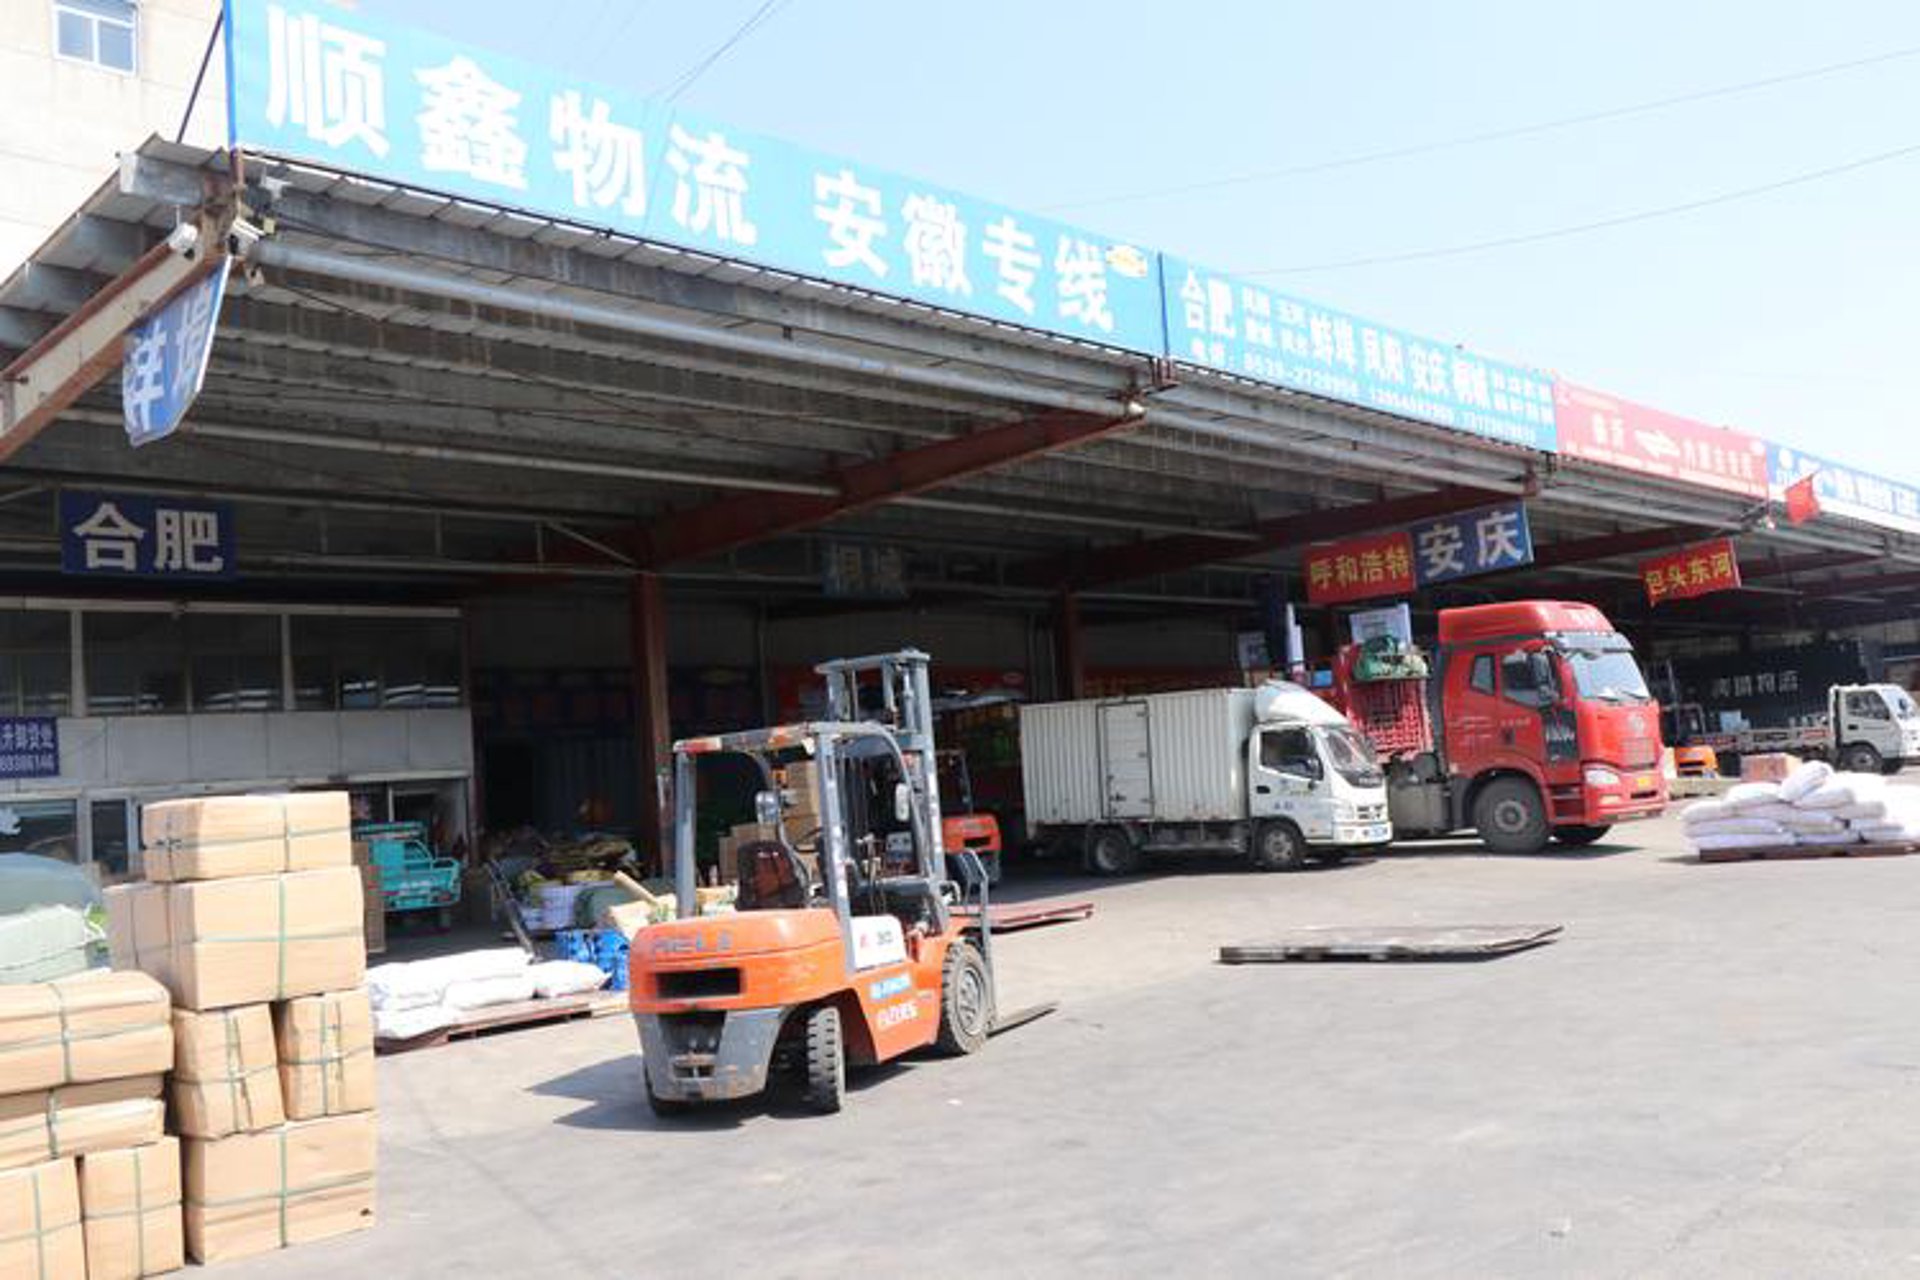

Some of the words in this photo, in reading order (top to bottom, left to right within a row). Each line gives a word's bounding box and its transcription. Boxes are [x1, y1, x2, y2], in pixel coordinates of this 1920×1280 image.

[266, 6, 757, 246] 顺鑫物流
[812, 168, 1115, 332] 安徽专线
[1180, 266, 1236, 338] 合肥
[73, 502, 224, 572] 合肥
[1309, 546, 1410, 590] 呼和浩特
[1418, 509, 1523, 578] 安庆
[1644, 551, 1734, 597] 包头东河
